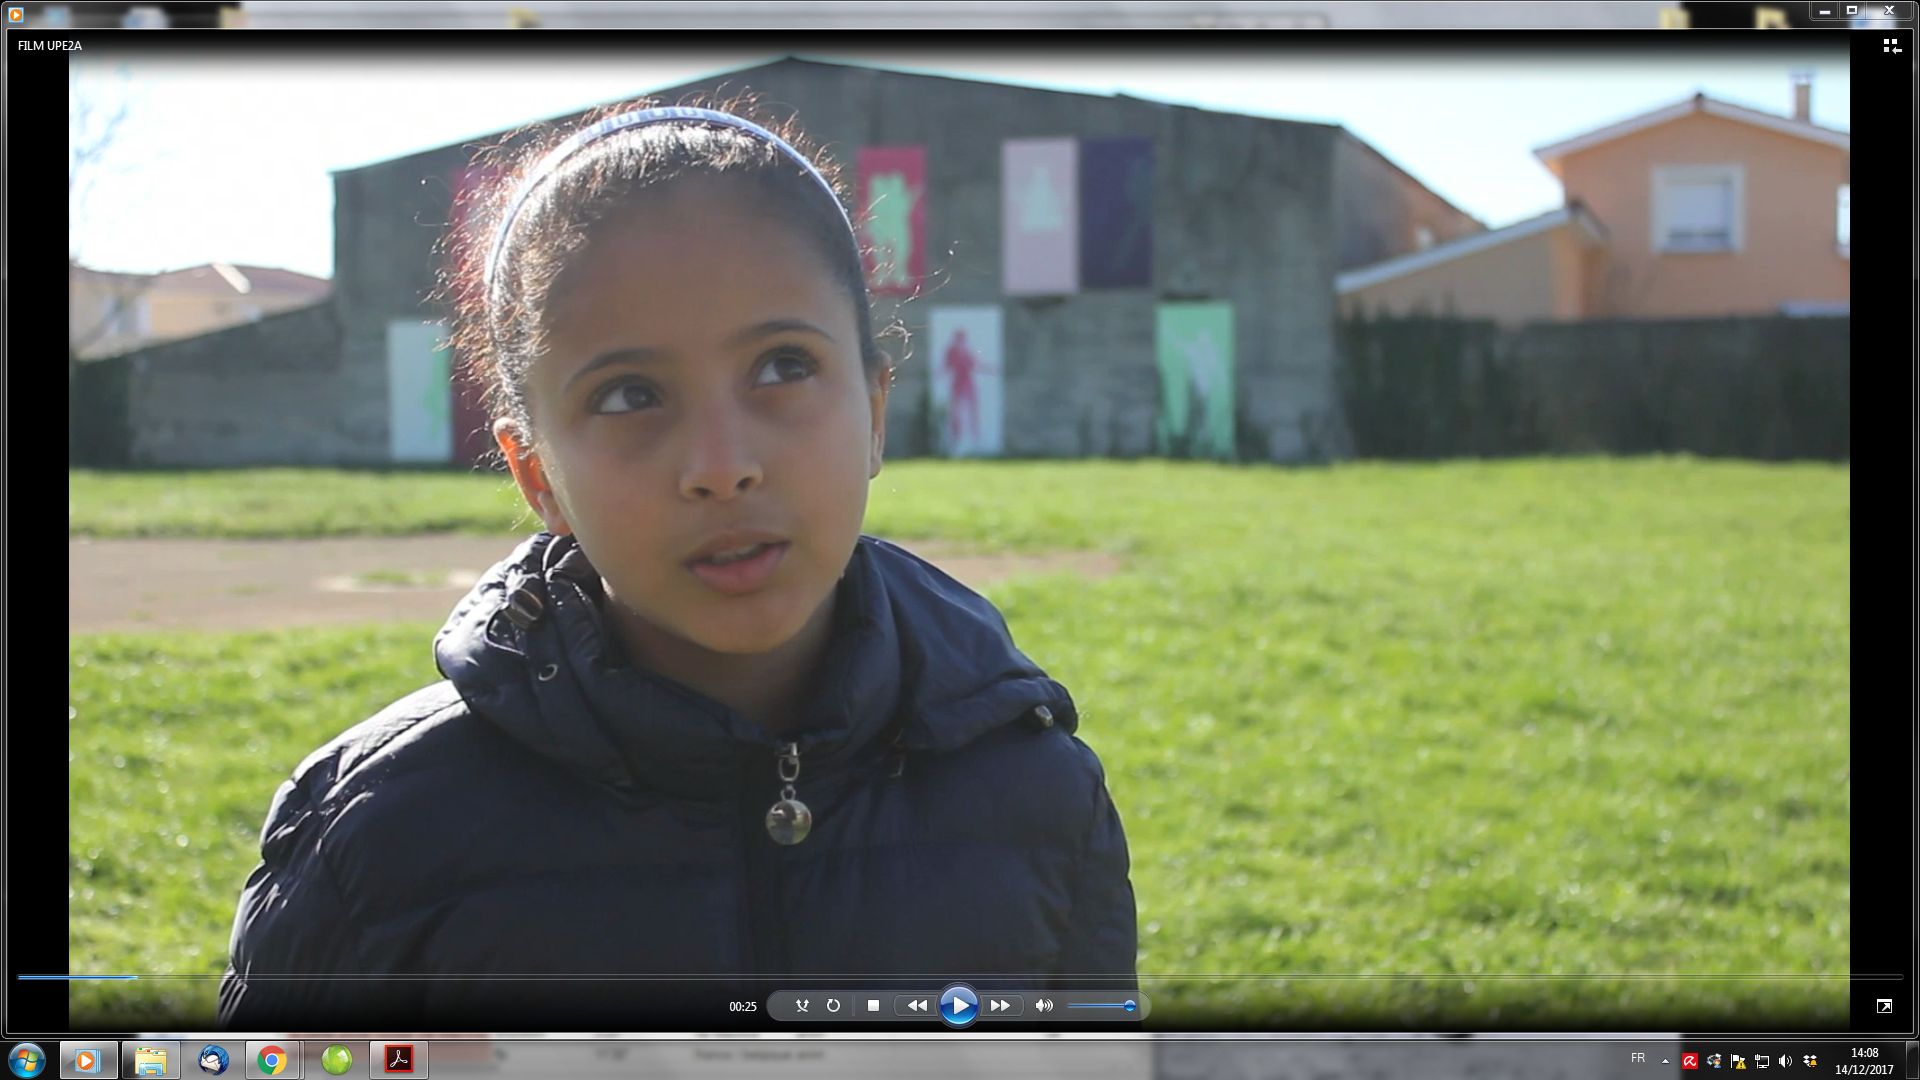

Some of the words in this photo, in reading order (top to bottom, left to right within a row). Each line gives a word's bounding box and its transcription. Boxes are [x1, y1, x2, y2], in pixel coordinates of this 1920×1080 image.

[18, 40, 44, 51] FILM
[47, 40, 83, 51] UPE2A
[729, 1001, 757, 1012] 00:25
[1631, 1052, 1646, 1063] FR
[1851, 1047, 1879, 1058] 14:08
[1835, 1064, 1894, 1076] 14/12/2017
